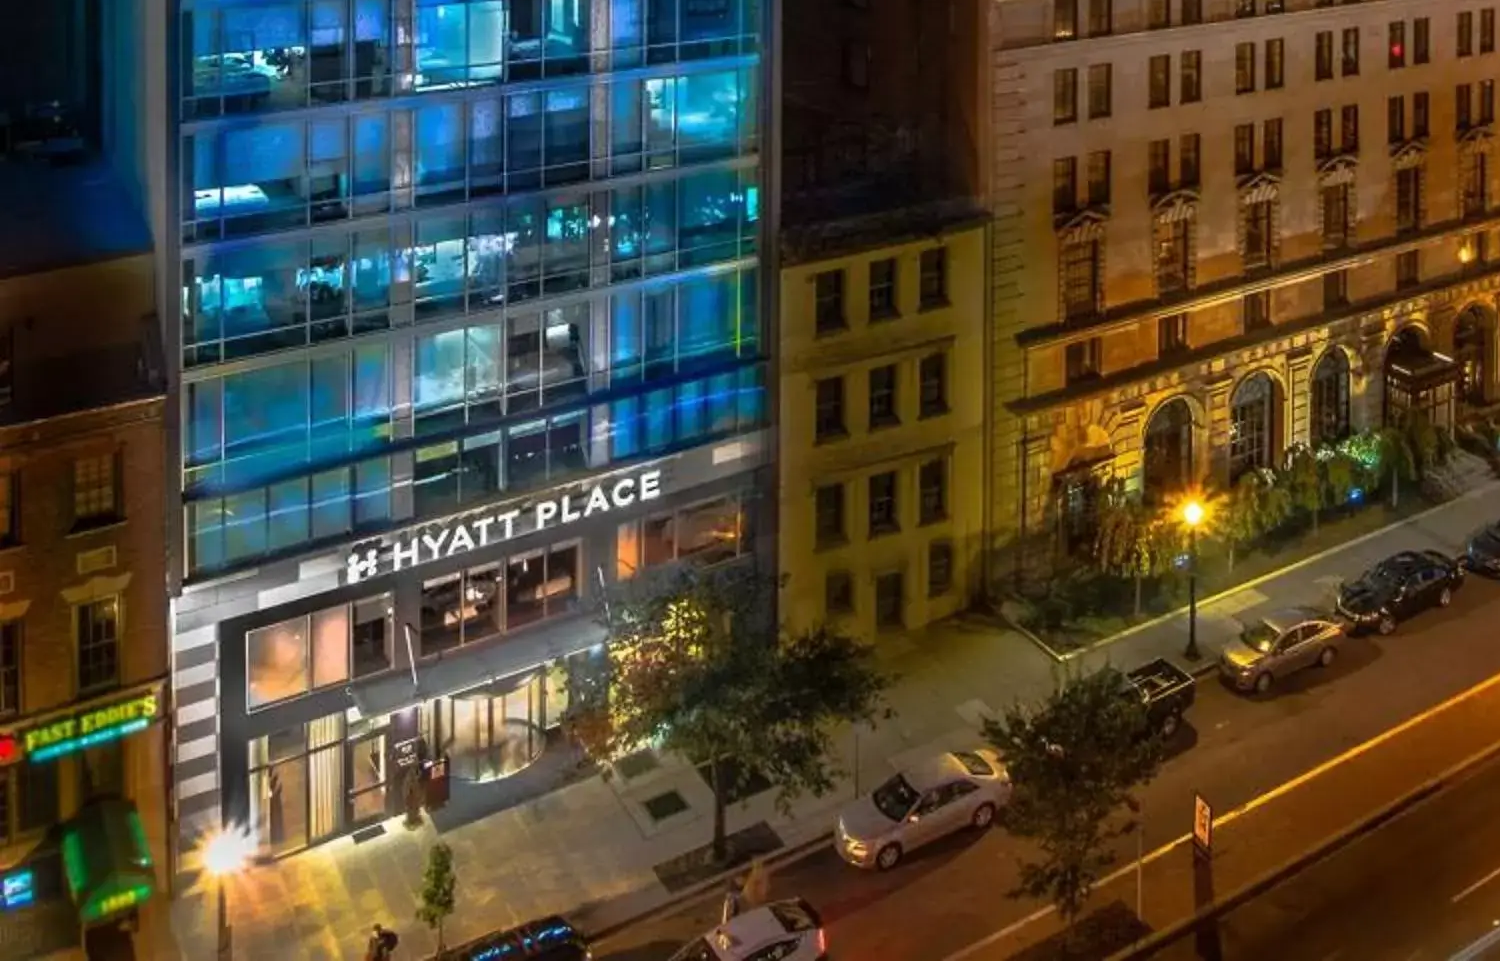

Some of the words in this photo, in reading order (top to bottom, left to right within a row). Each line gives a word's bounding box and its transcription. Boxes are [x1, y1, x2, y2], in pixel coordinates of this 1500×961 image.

[393, 509, 520, 571] HYATT
[536, 470, 661, 530] PLACE
[26, 719, 76, 752] FAST
